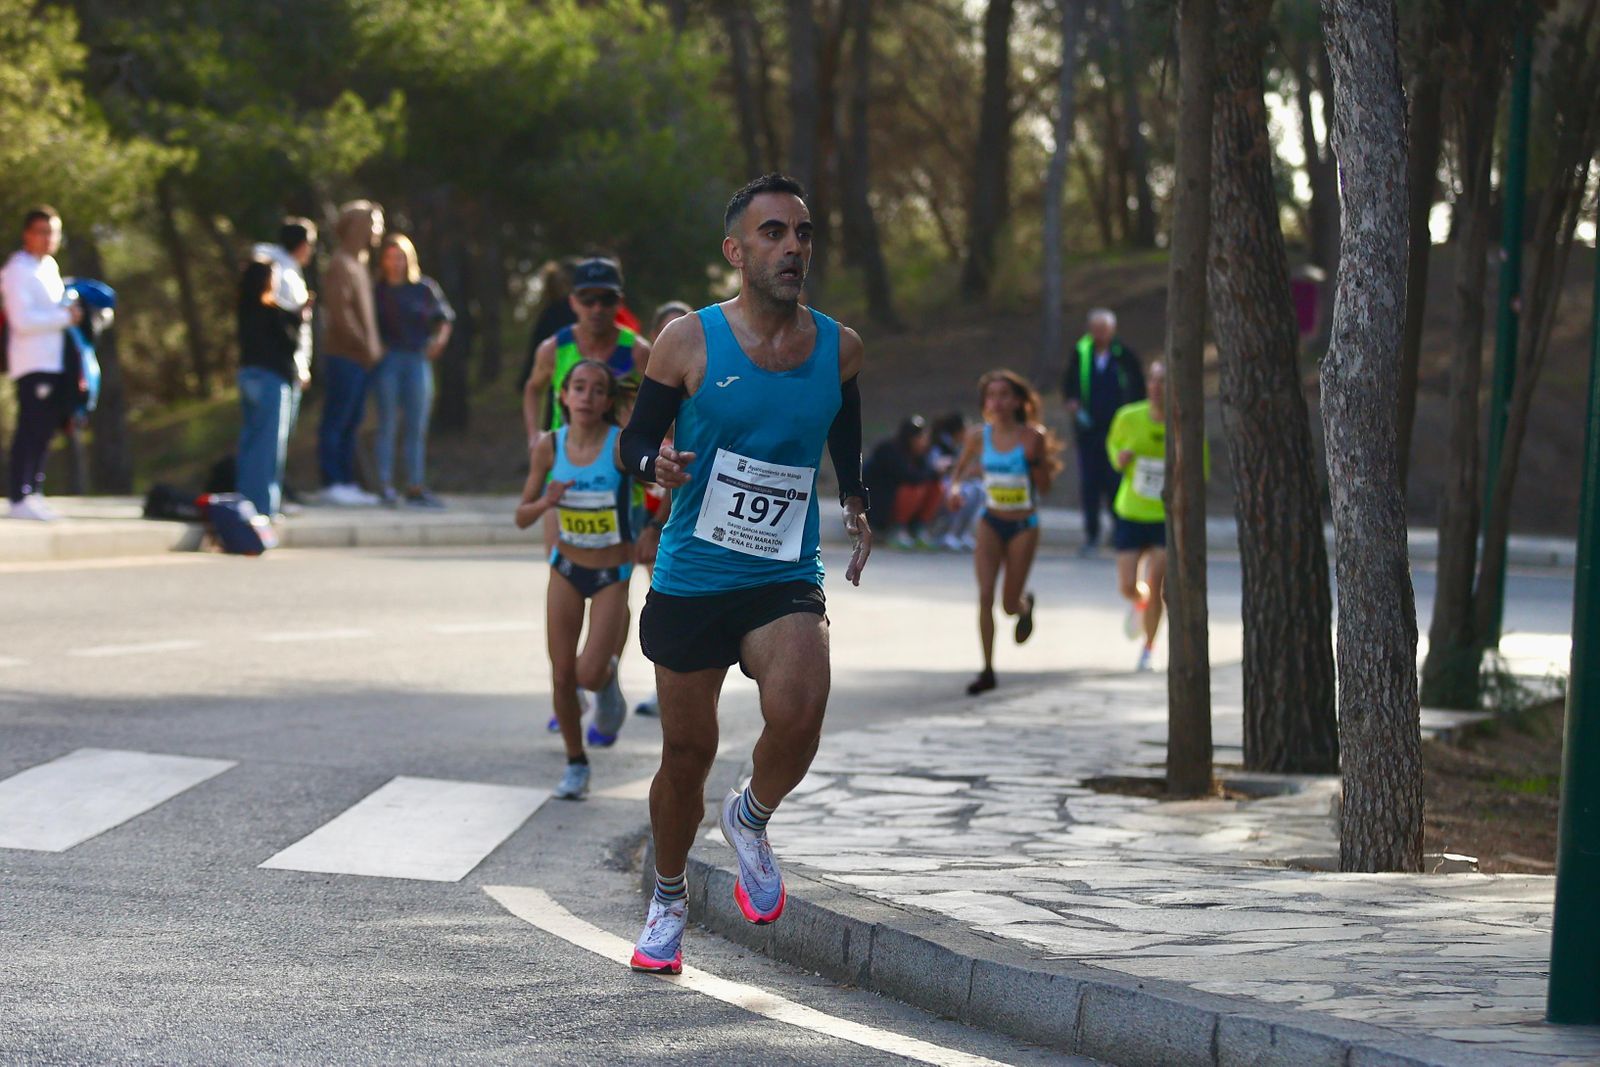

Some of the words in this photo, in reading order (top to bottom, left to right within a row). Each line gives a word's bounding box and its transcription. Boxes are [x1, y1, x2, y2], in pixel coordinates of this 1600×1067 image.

[747, 465, 780, 477] Ayuntamiento
[727, 491, 790, 527] 197
[566, 517, 610, 534] 1015
[727, 521, 741, 530] DAVID
[740, 532, 753, 540] MINI
